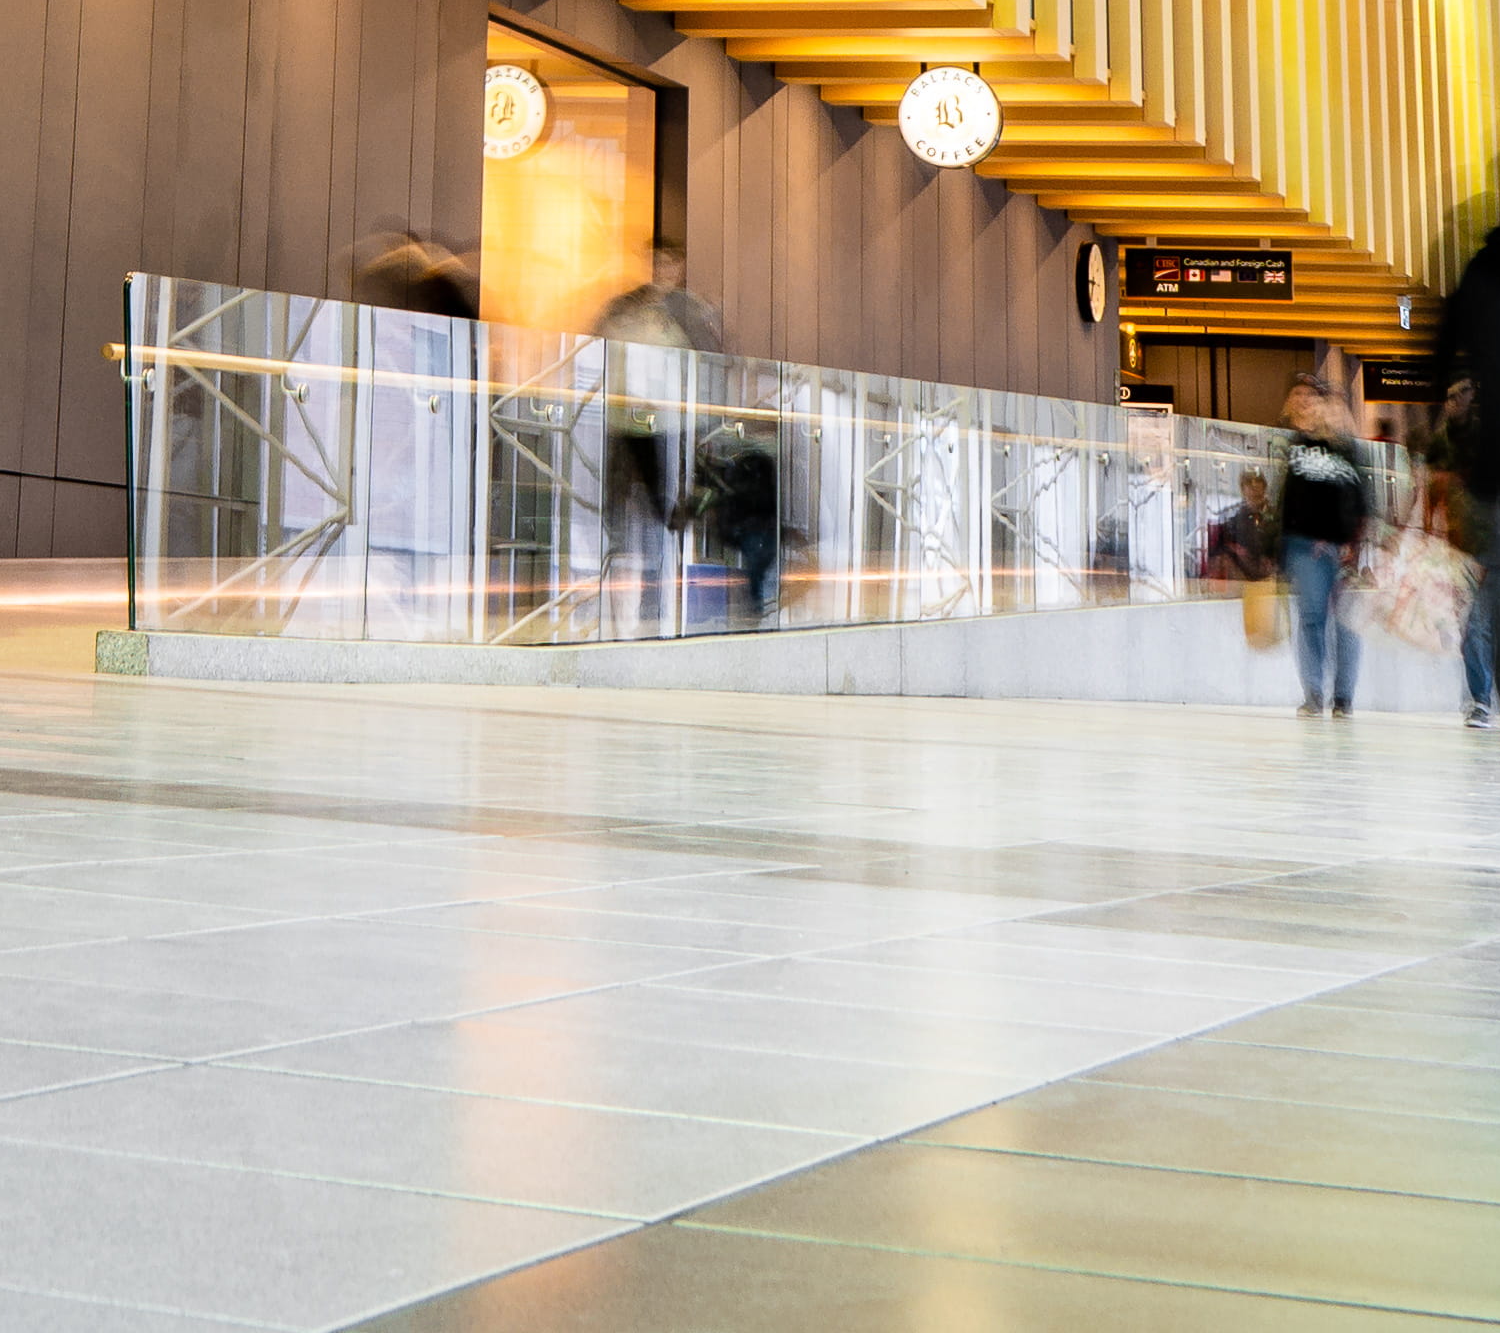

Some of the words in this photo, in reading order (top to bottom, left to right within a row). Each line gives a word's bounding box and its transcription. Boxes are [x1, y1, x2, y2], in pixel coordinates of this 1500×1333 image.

[916, 137, 986, 161] COFFEE
[1183, 257, 1219, 267] Canadian
[1220, 259, 1235, 267] and
[1265, 259, 1285, 268] Cash
[1156, 283, 1179, 293] ATM
